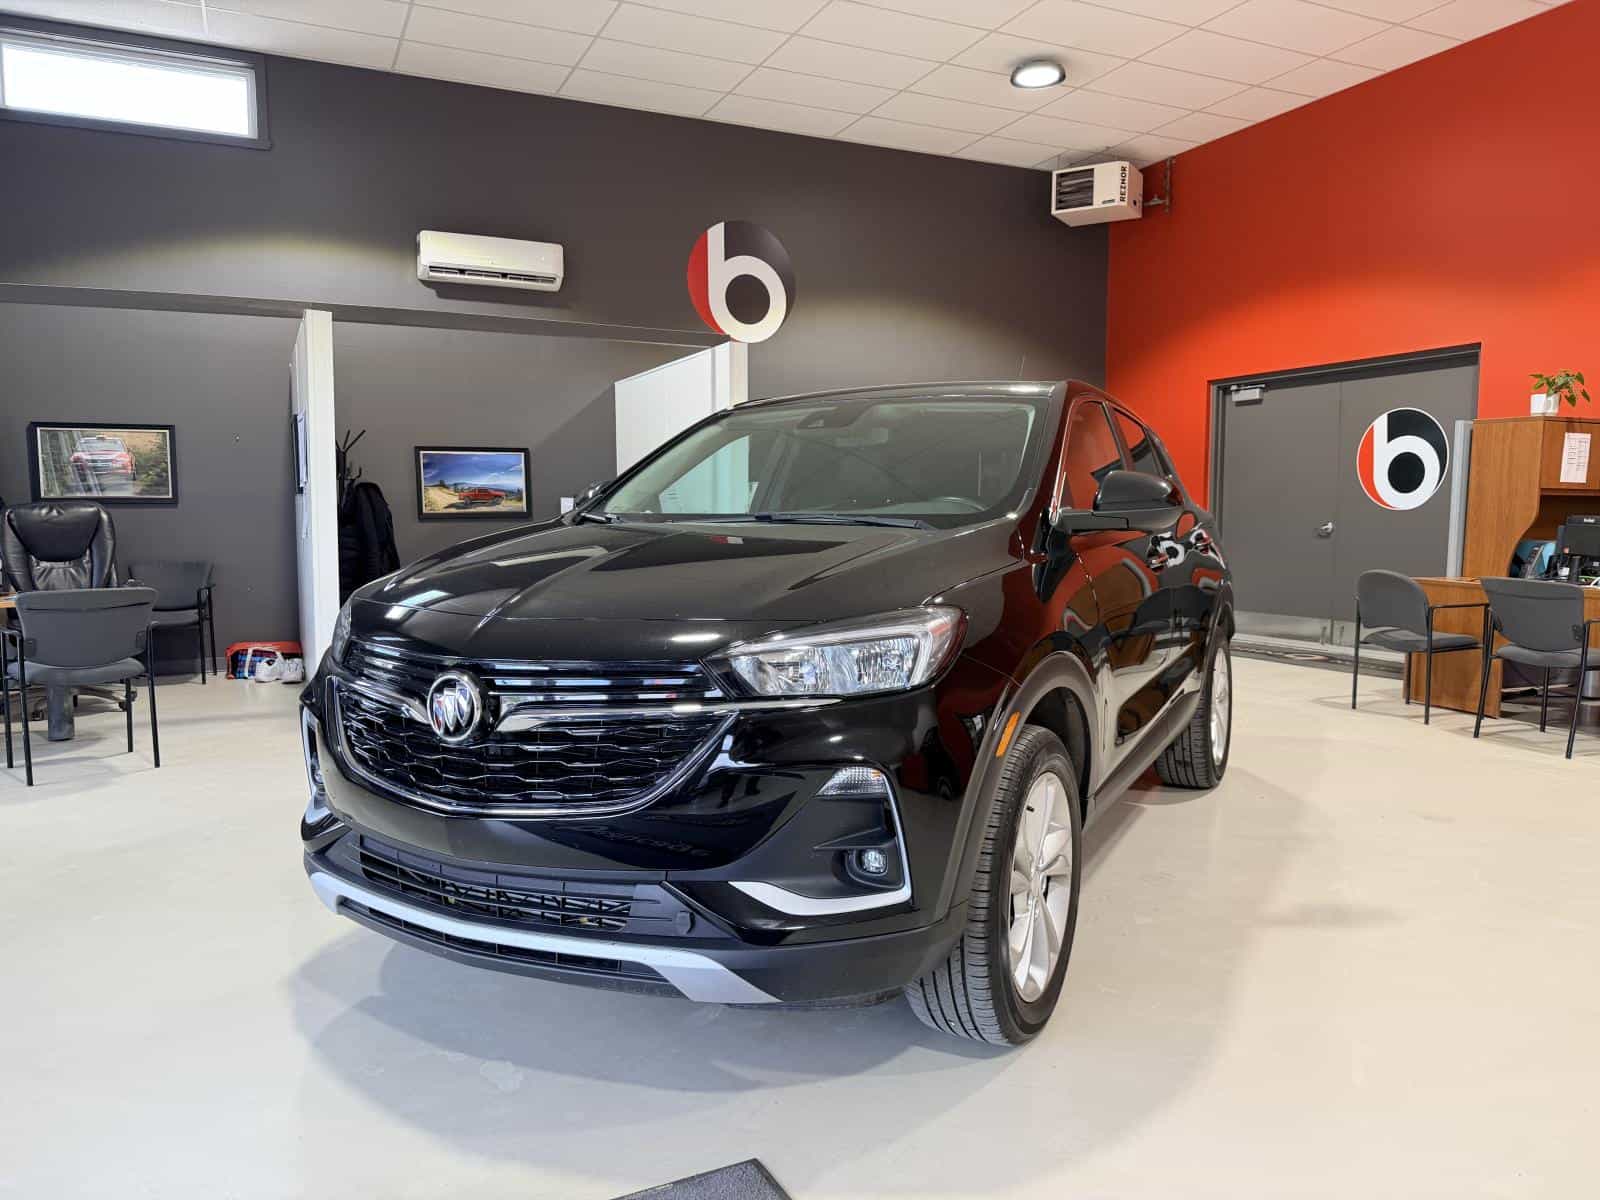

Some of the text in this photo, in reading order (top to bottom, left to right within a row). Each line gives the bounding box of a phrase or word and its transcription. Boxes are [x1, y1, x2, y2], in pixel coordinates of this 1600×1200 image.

[1120, 165, 1128, 202] REZNOR
[706, 221, 787, 343] b
[1372, 410, 1441, 510] b
